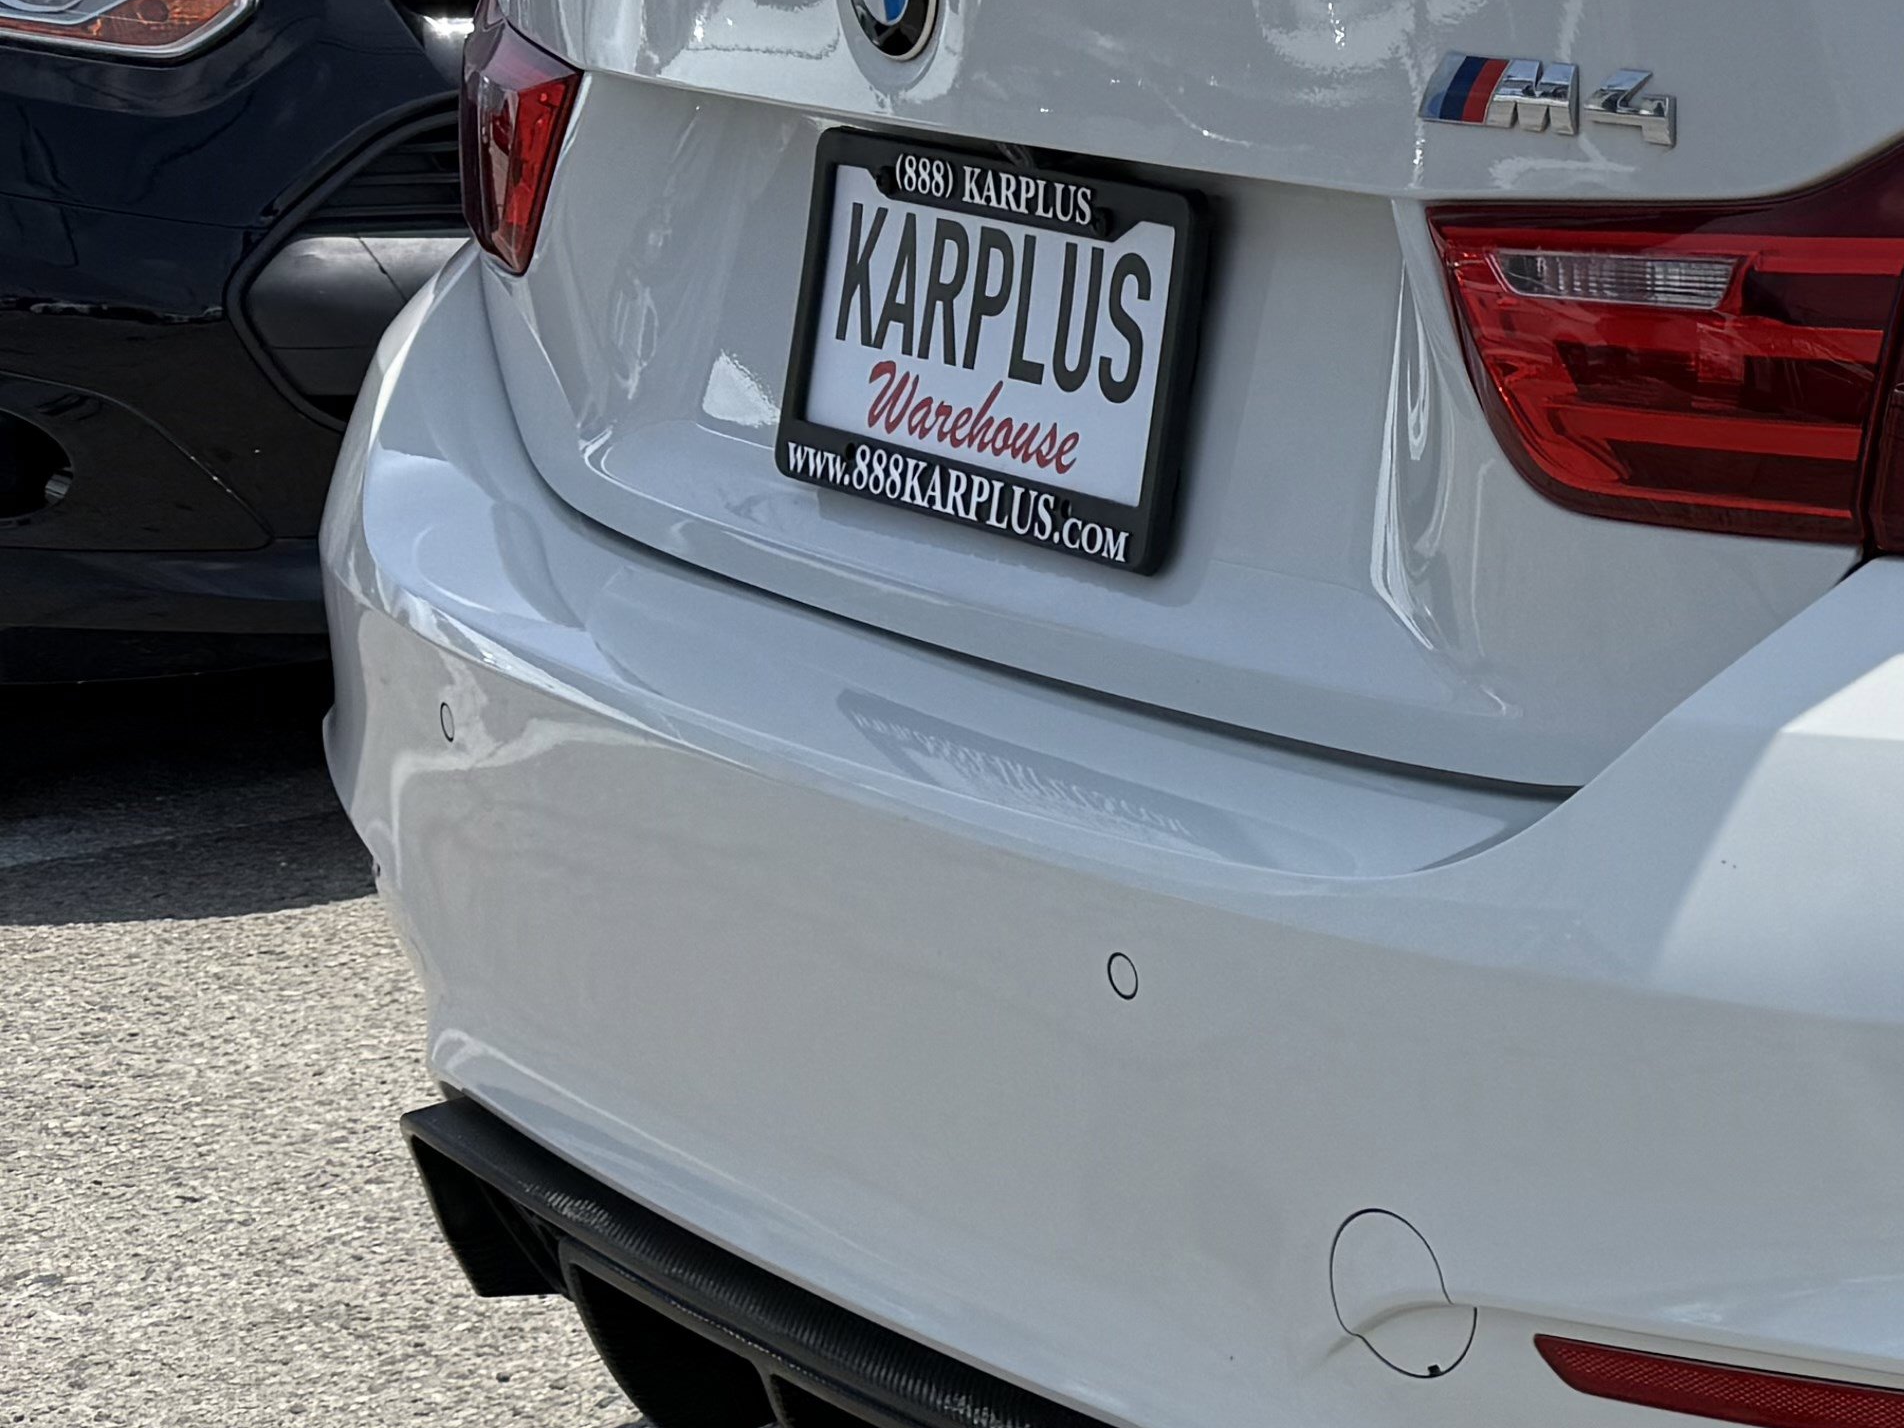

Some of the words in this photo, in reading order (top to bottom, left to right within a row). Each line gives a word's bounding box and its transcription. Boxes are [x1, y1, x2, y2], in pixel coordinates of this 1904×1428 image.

[895, 153, 954, 199] (888)
[961, 165, 1093, 226] KARPLUS
[835, 202, 1152, 404] KARPLUS
[867, 360, 1081, 475] Warehouse
